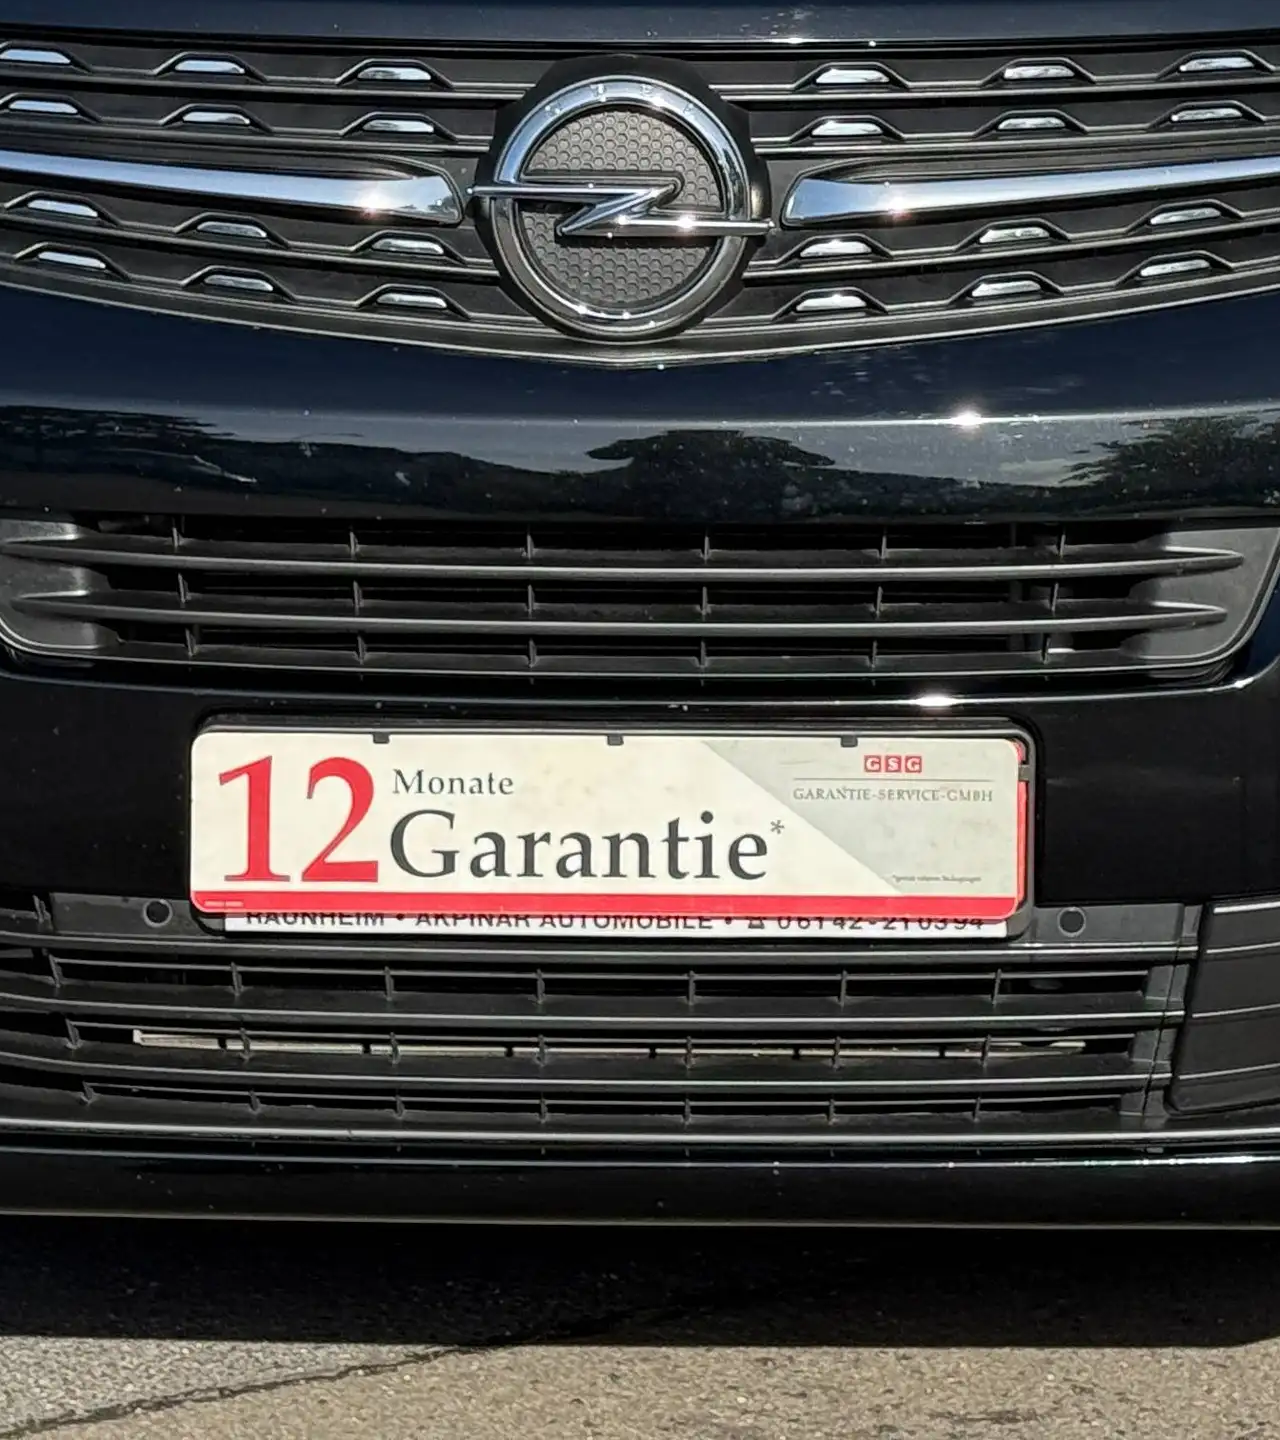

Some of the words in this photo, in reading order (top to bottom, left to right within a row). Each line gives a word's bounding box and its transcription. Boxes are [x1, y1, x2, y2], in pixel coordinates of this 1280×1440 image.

[865, 756, 921, 772] GSG
[393, 769, 515, 796] Monate
[793, 787, 993, 802] GARANTIE-SERVICE-GMBH
[219, 755, 379, 883] 12
